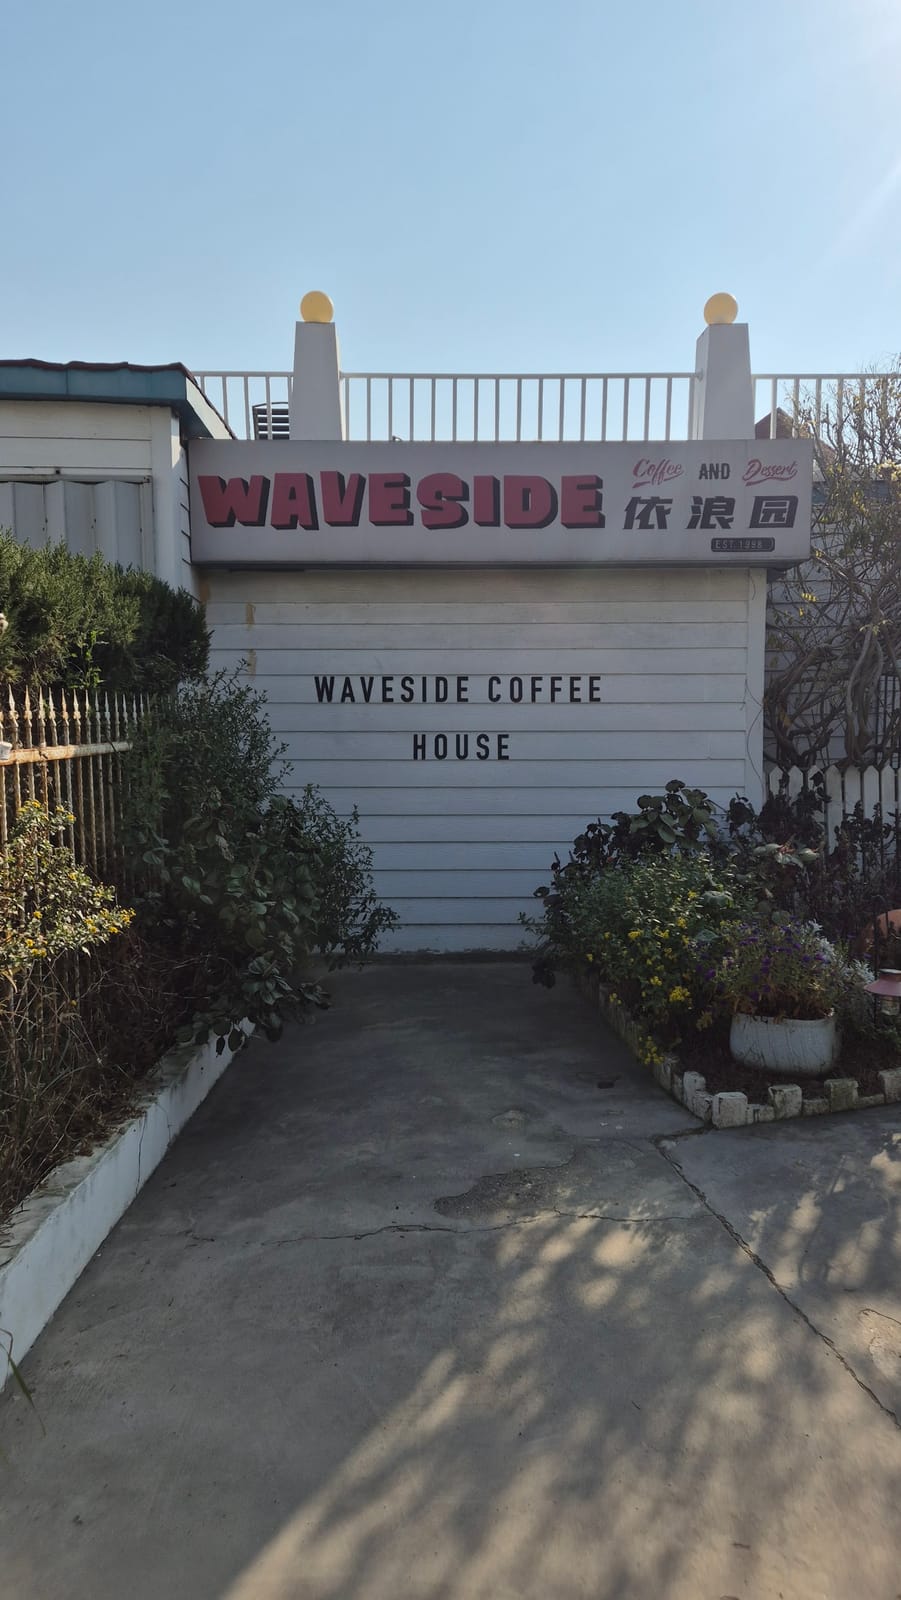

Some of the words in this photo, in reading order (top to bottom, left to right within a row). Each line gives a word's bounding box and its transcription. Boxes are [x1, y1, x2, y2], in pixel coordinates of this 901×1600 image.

[632, 458, 684, 488] Coffee
[699, 463, 730, 480] AND
[742, 459, 798, 486] Dessert
[198, 471, 605, 530] WAVESIDE
[622, 495, 799, 530] 依浪园
[314, 676, 469, 703] WAVESIDE
[488, 676, 601, 703] COFFEE
[413, 733, 510, 760] HOUSE
